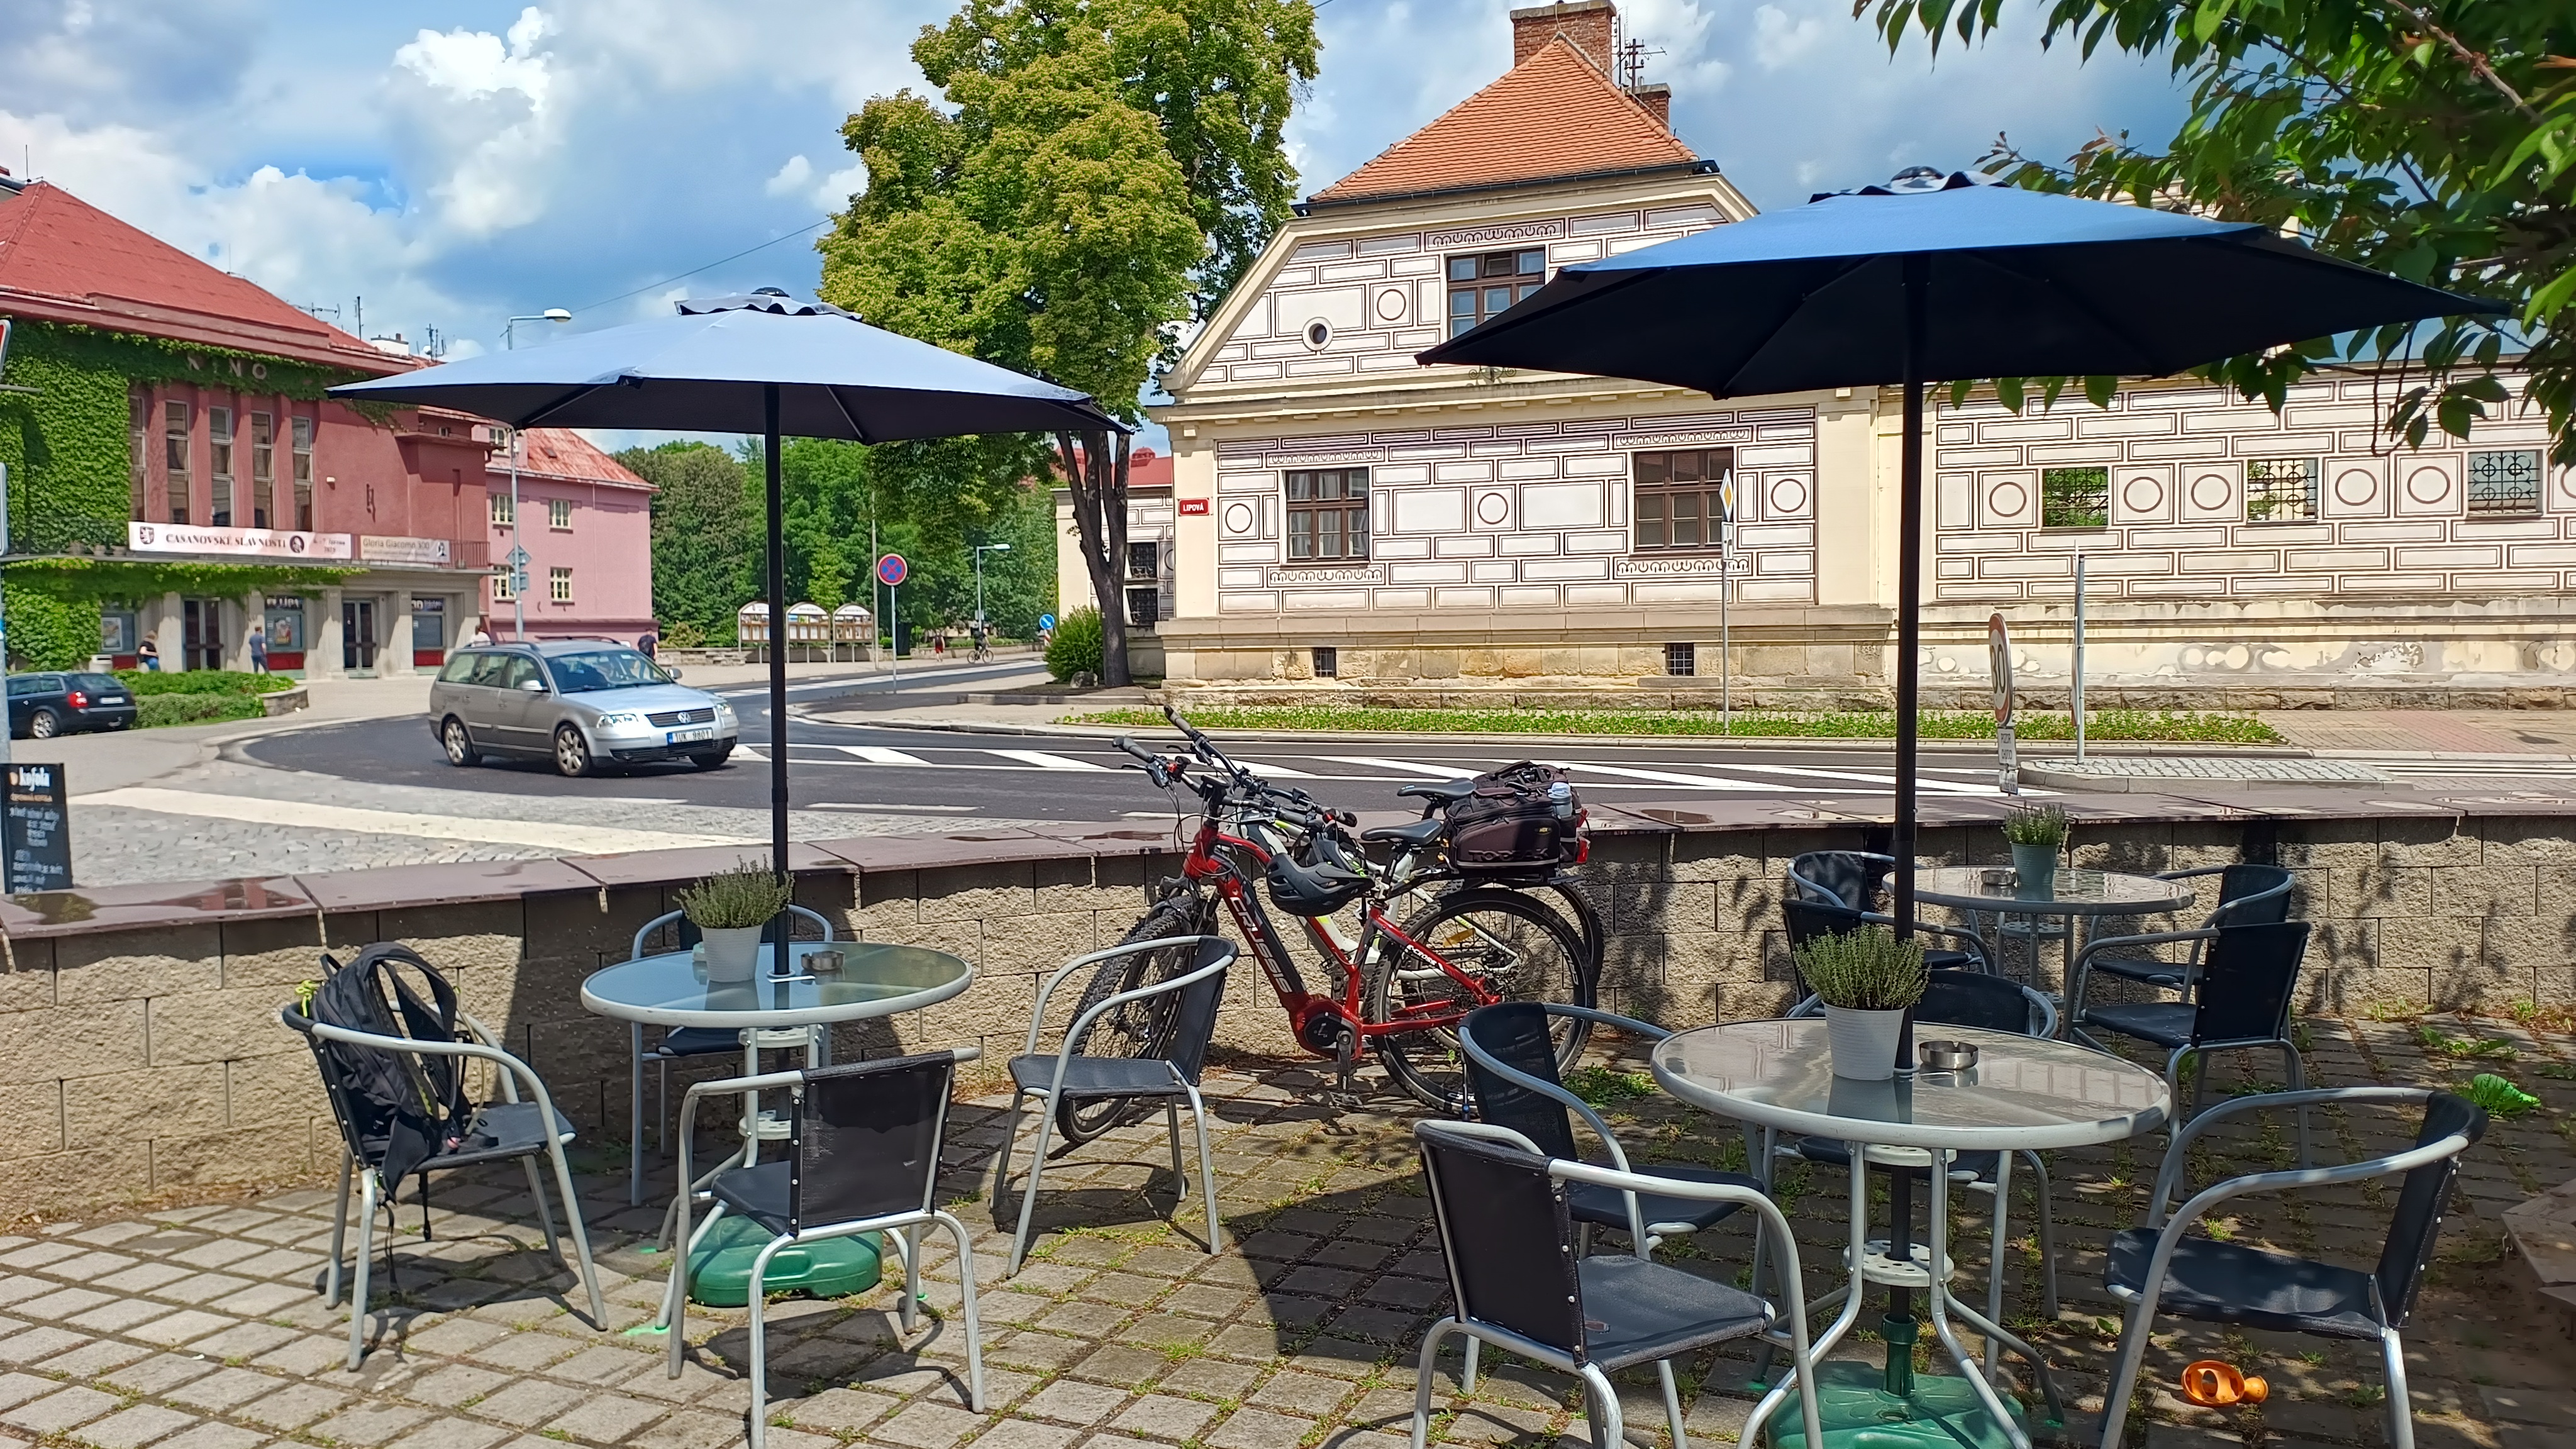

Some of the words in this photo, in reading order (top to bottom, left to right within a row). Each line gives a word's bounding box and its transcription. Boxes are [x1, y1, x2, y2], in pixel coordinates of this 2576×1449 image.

[1182, 502, 1204, 512] LIPOVÁ
[165, 533, 233, 547] CASANOVSKÉ
[235, 537, 286, 548] SLAVNOSTI
[363, 538, 384, 548] Gloria
[386, 539, 416, 550] Giacomo
[1990, 643, 2006, 694] 30
[19, 766, 50, 792] kofola
[1230, 897, 1293, 993] CRUSSIS
